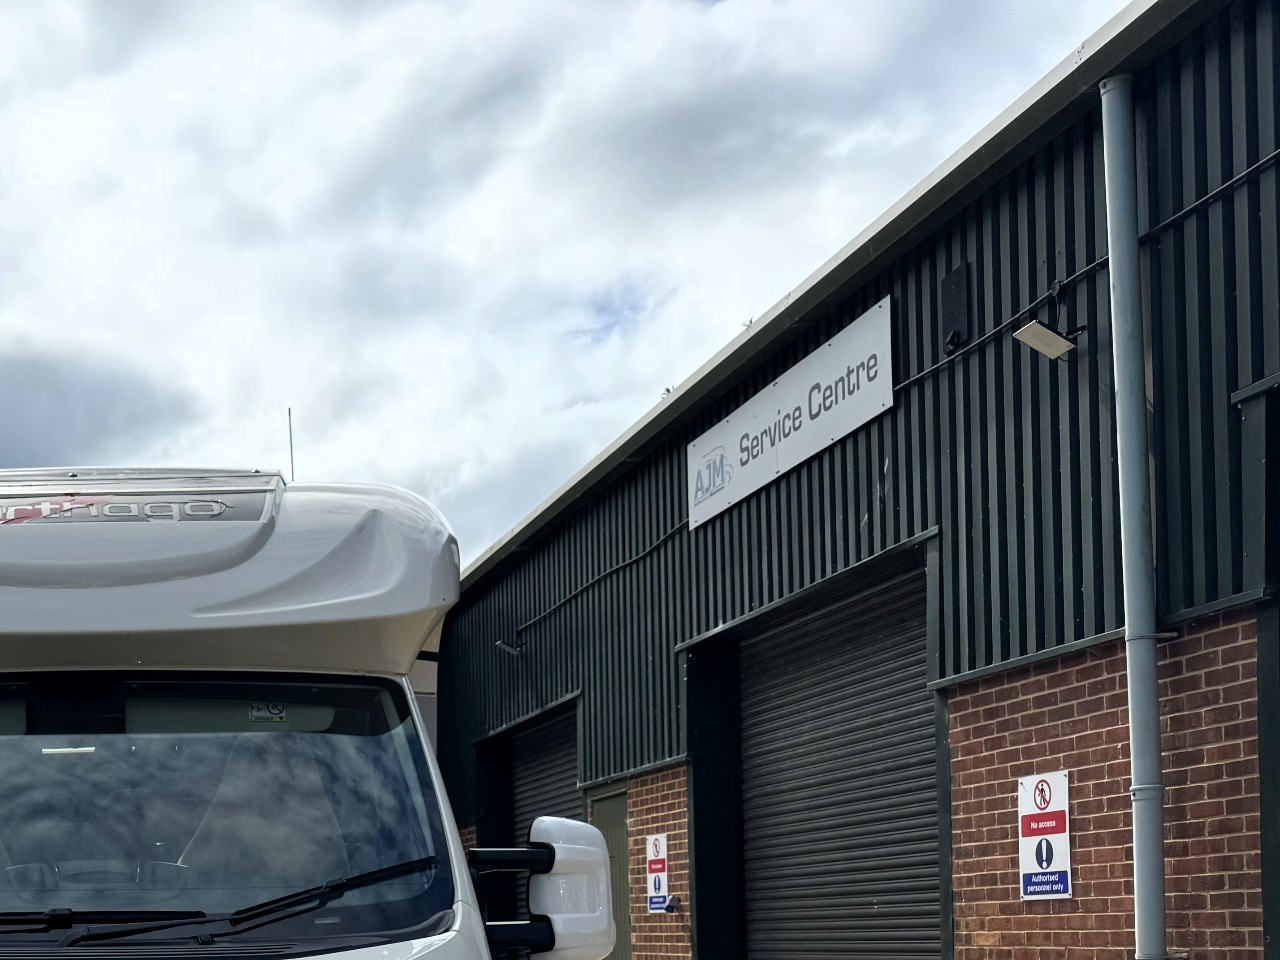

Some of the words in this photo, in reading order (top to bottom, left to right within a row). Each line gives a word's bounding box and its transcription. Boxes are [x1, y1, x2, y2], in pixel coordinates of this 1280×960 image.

[739, 405, 803, 467] Service
[808, 352, 879, 421] Centre
[694, 453, 725, 500] AJM
[1030, 821, 1038, 829] No
[1038, 820, 1056, 829] access
[1031, 873, 1059, 883] Authorised
[1027, 883, 1052, 894] personnel
[1052, 883, 1064, 893] only
